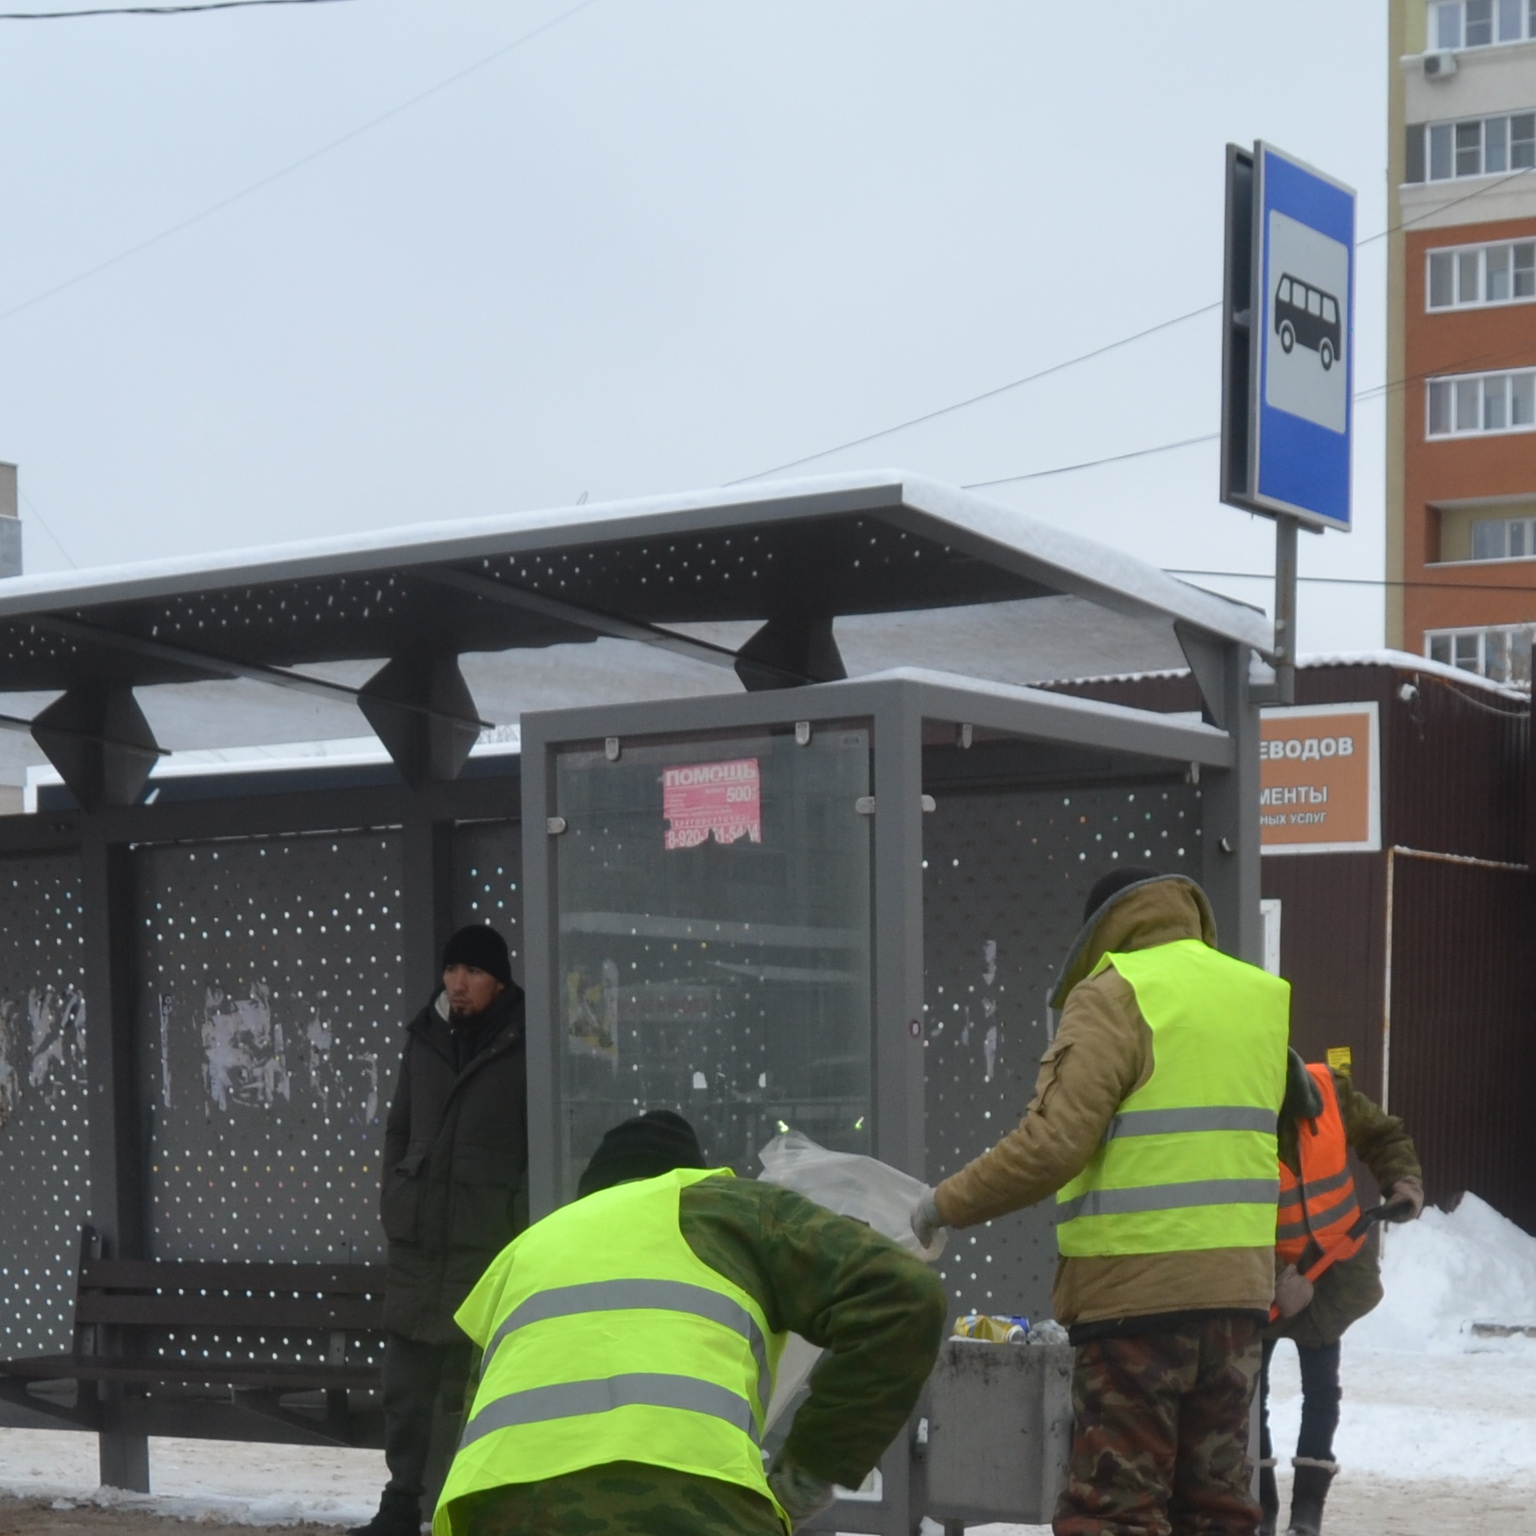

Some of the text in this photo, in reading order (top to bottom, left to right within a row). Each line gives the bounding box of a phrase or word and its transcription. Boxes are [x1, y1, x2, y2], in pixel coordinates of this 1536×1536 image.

[1260, 736, 1353, 760] ЕВОДОВ
[666, 763, 755, 786] ПОМОЩЬ
[727, 786, 751, 803] 500
[1259, 785, 1328, 806] МЕНТЫ
[1259, 811, 1327, 826] НЫХ УСЛУГ
